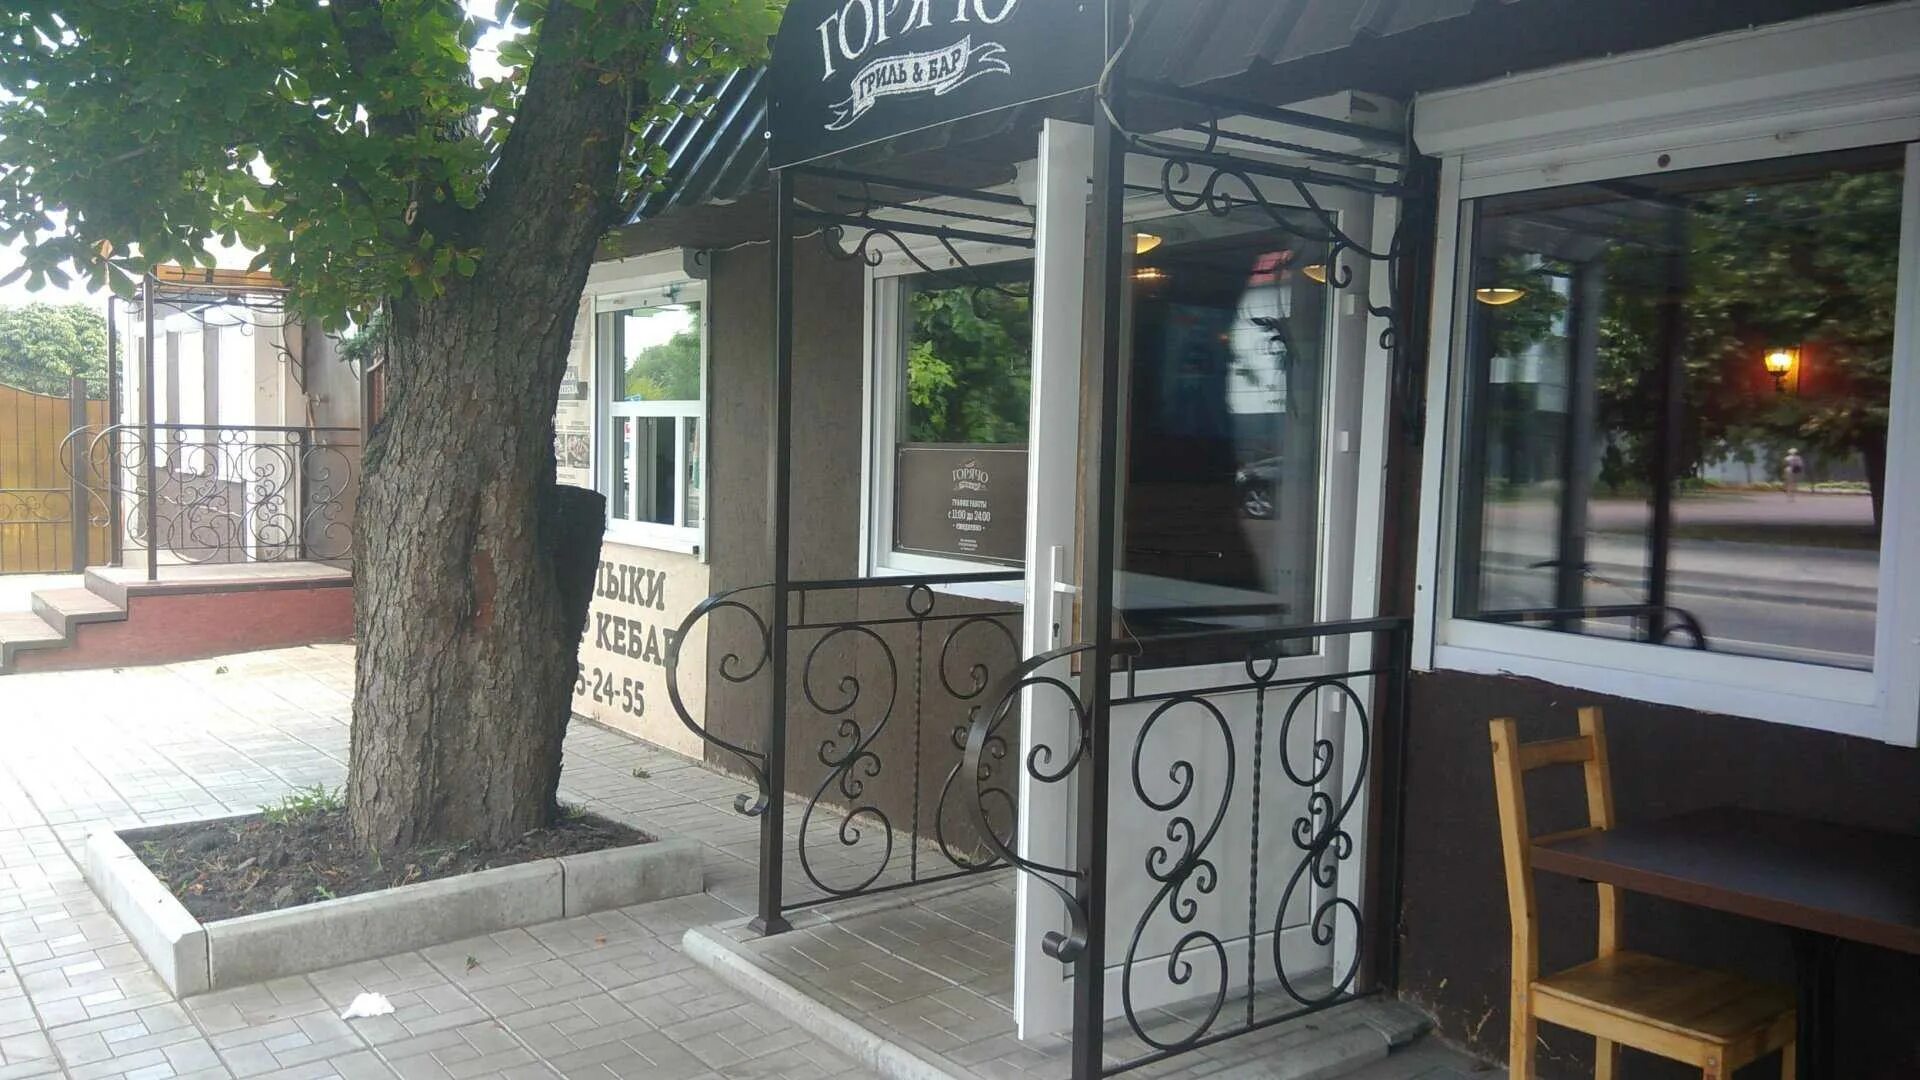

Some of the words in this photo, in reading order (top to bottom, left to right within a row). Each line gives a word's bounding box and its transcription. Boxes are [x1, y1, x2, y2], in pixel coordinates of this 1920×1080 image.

[859, 61, 907, 99] ГРИЛЬ
[912, 61, 923, 83] &
[928, 48, 961, 80] БАР
